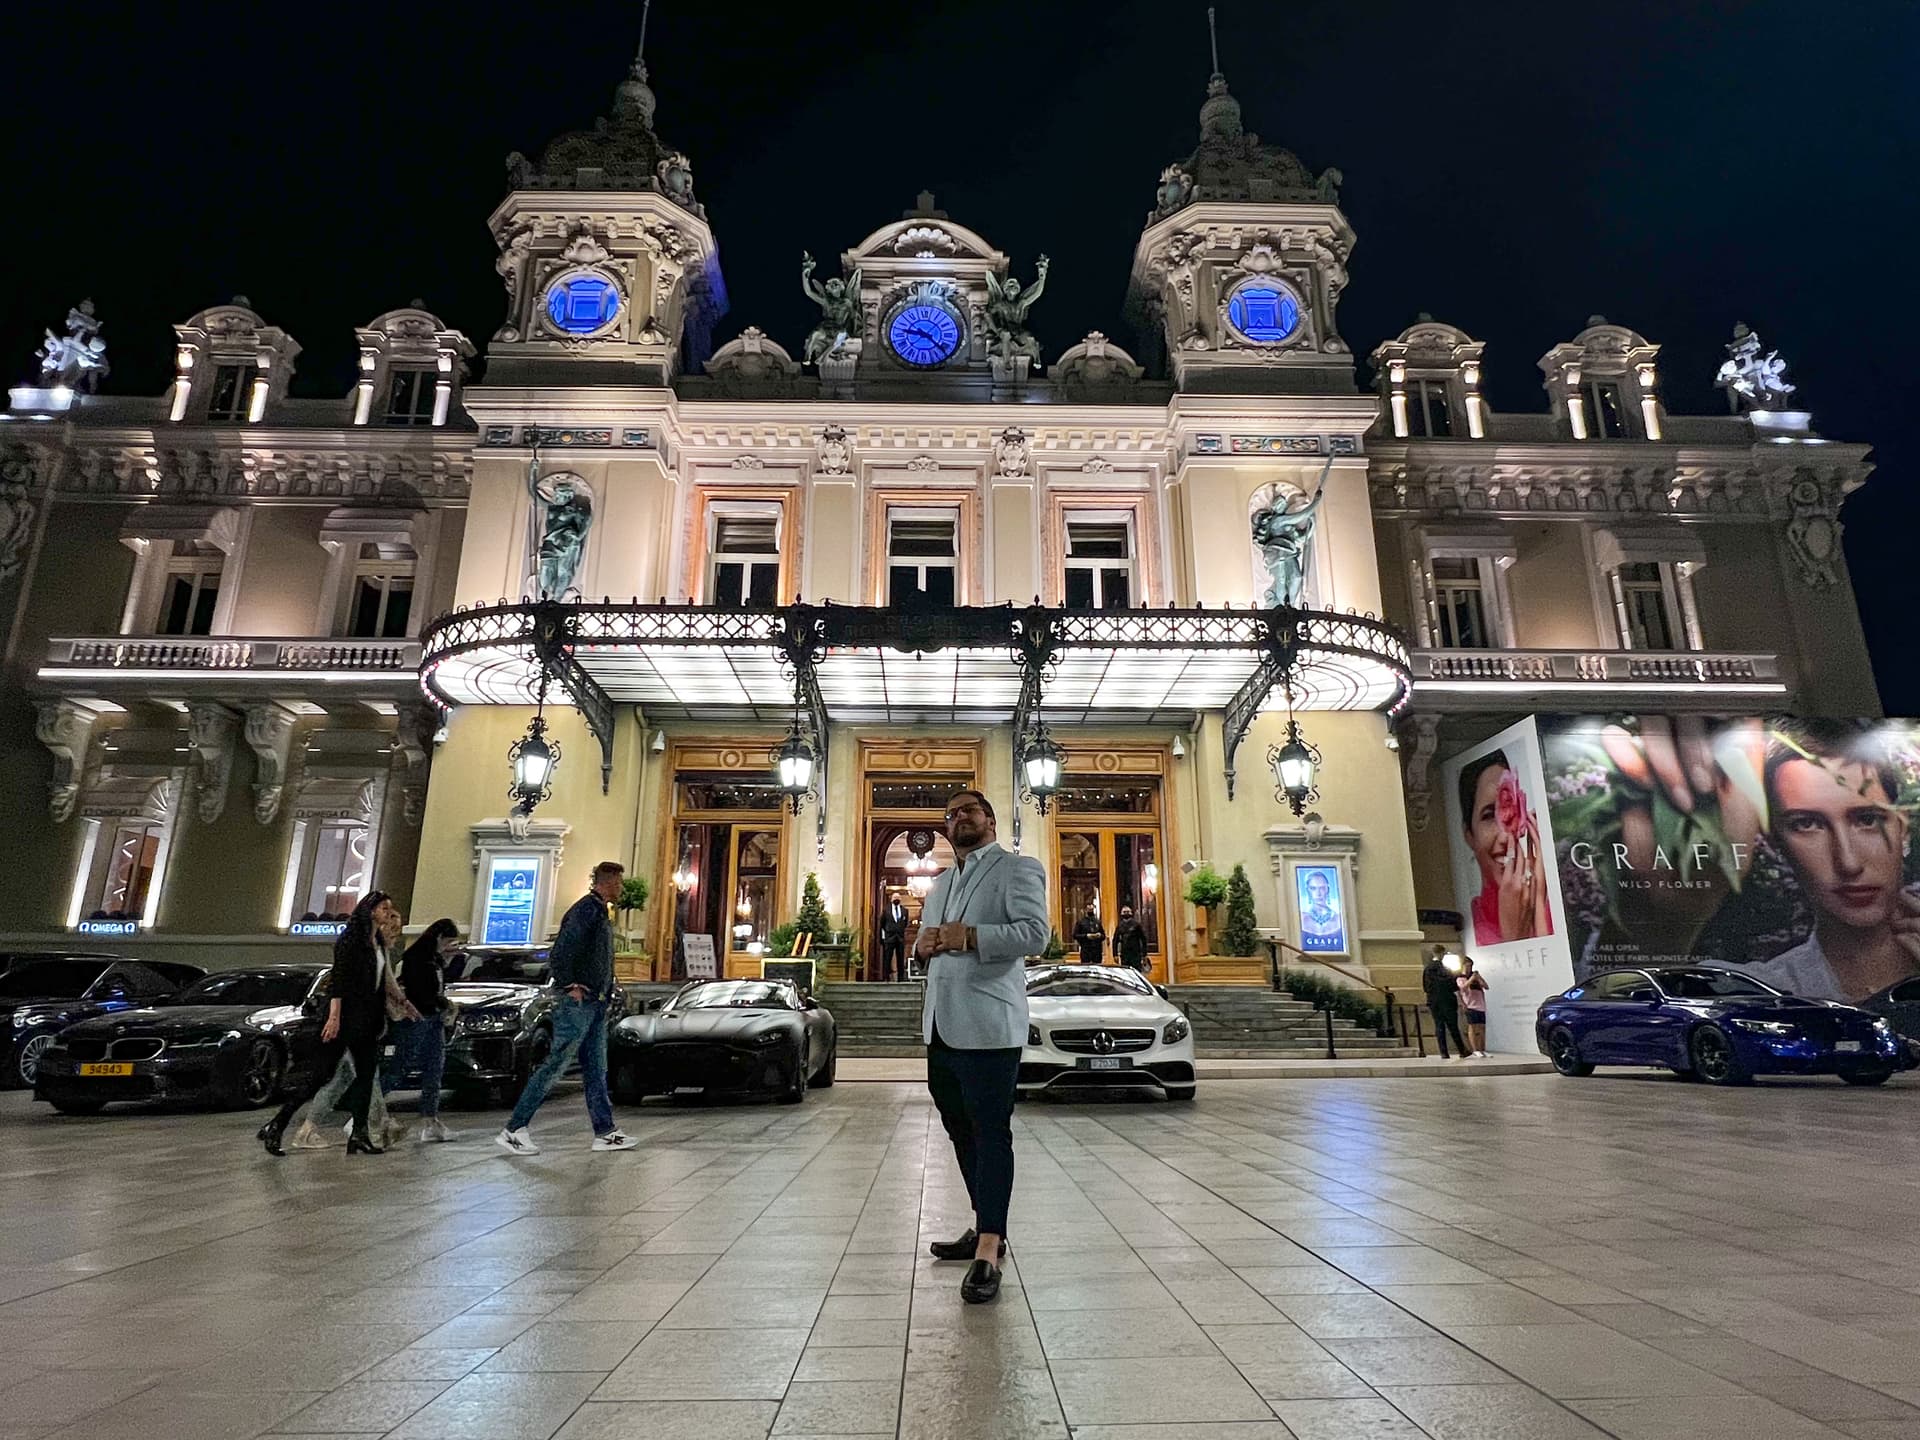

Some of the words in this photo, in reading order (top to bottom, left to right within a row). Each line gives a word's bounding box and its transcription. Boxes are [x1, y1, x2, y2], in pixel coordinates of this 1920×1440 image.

[1570, 841, 1748, 870] GRAFF
[1618, 880, 1652, 889] WILD
[1659, 880, 1712, 889] FLOWER
[91, 923, 123, 933] OMEGA
[303, 924, 336, 934] OMEGA
[1306, 937, 1339, 946] GRAFF
[1616, 944, 1640, 952] OPEN
[1627, 954, 1650, 962] PARIS
